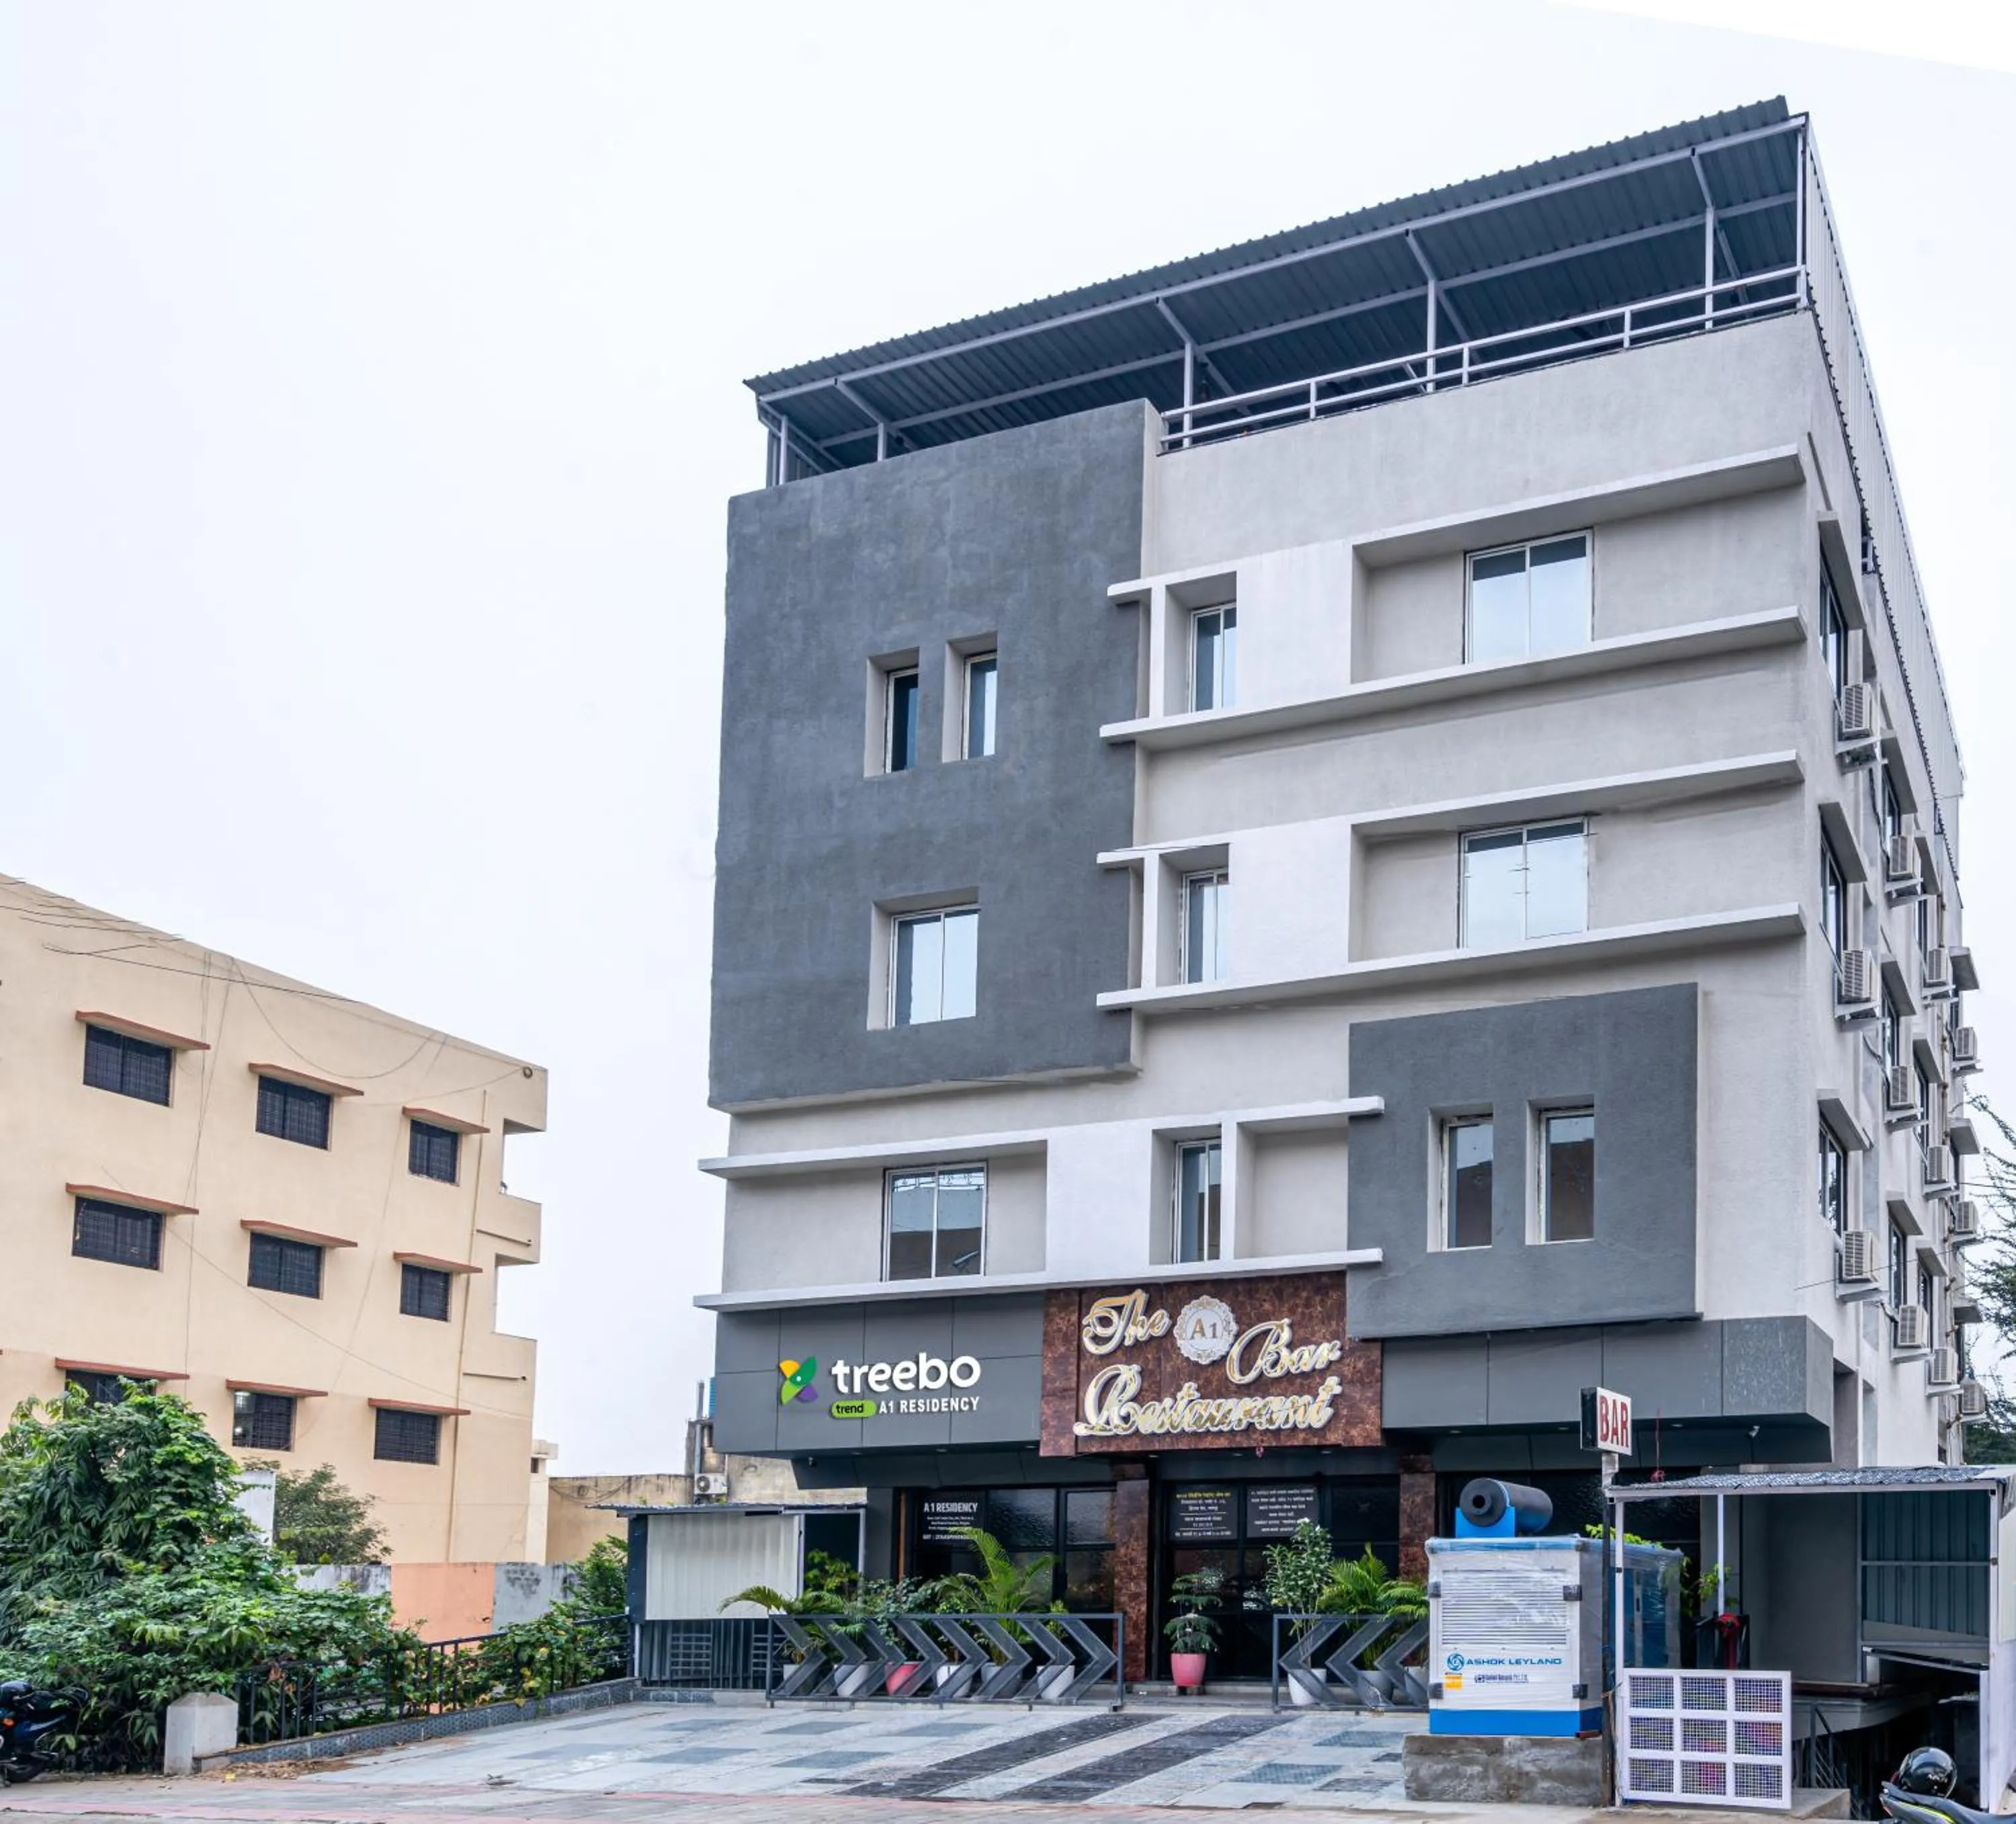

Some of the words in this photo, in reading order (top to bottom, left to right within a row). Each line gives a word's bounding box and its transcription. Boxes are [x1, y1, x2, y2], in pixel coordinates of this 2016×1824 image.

[1082, 1288, 1171, 1356] The
[1189, 1317, 1218, 1341] A1
[1226, 1317, 1343, 1384] Bar
[831, 1352, 982, 1394] treebo
[836, 1403, 865, 1414] trend
[879, 1400, 894, 1414] A1
[900, 1396, 980, 1413] RESIDENCY
[1073, 1363, 1343, 1437] Restaurant
[1599, 1395, 1630, 1448] BAR
[936, 1502, 978, 1513] RESIDENCY
